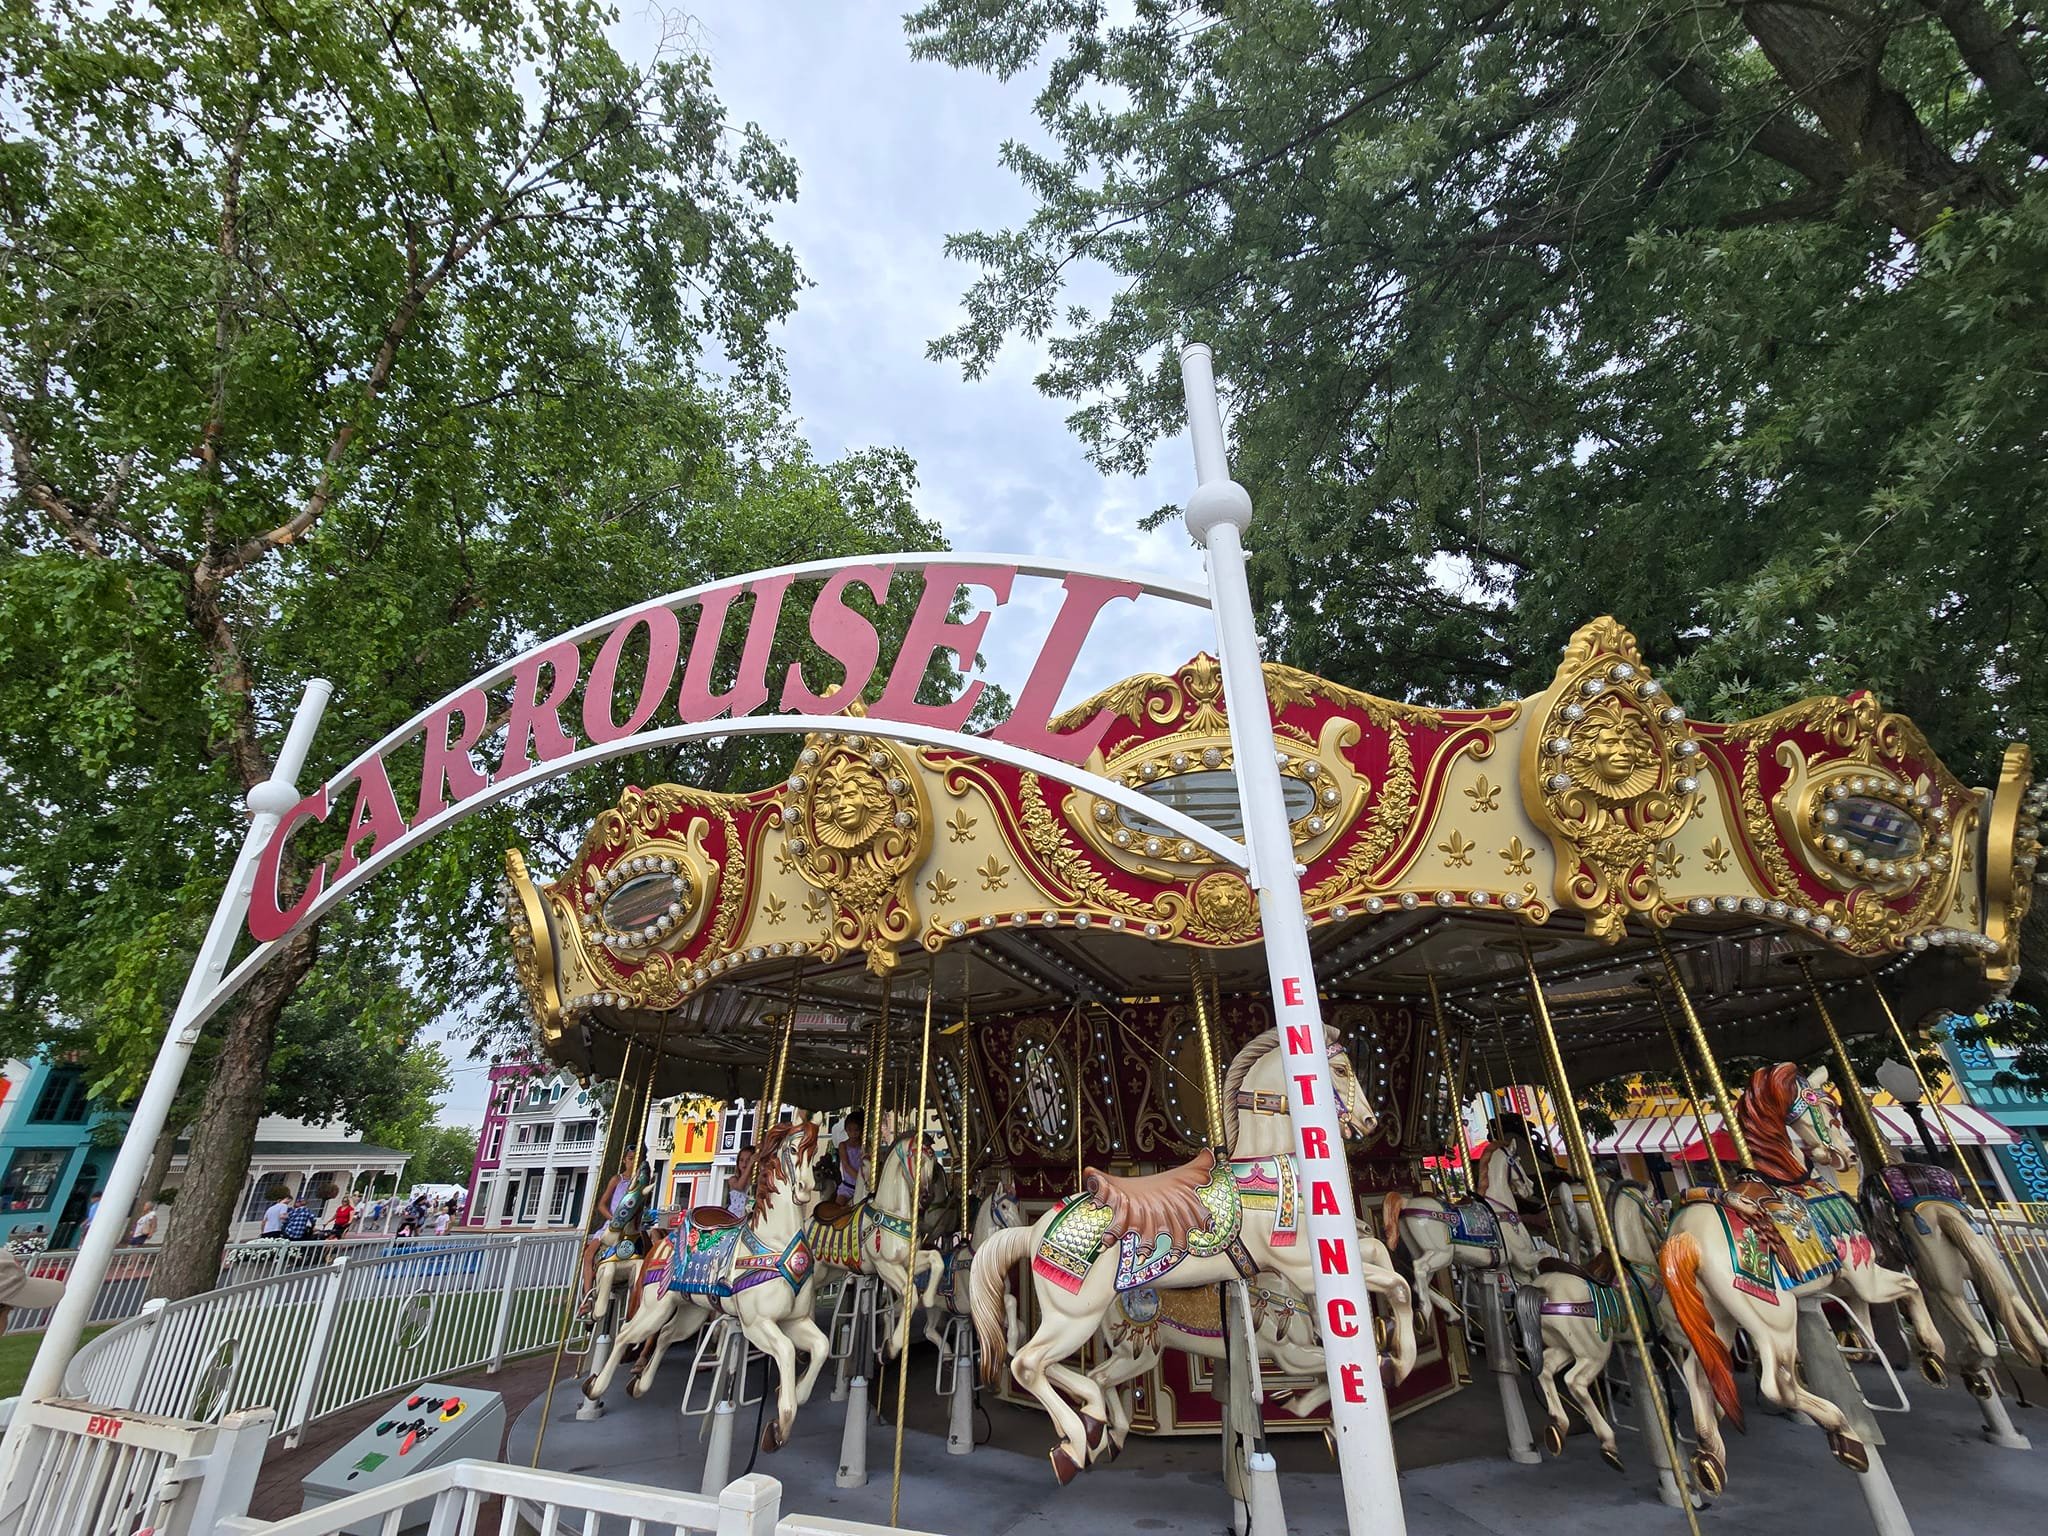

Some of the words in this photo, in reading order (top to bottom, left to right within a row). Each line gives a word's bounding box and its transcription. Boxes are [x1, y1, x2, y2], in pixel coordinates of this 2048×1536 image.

[248, 563, 1143, 943] CARROUSEL
[1281, 976, 1367, 1403] ENTRANCE
[86, 1415, 123, 1439] EXIT
